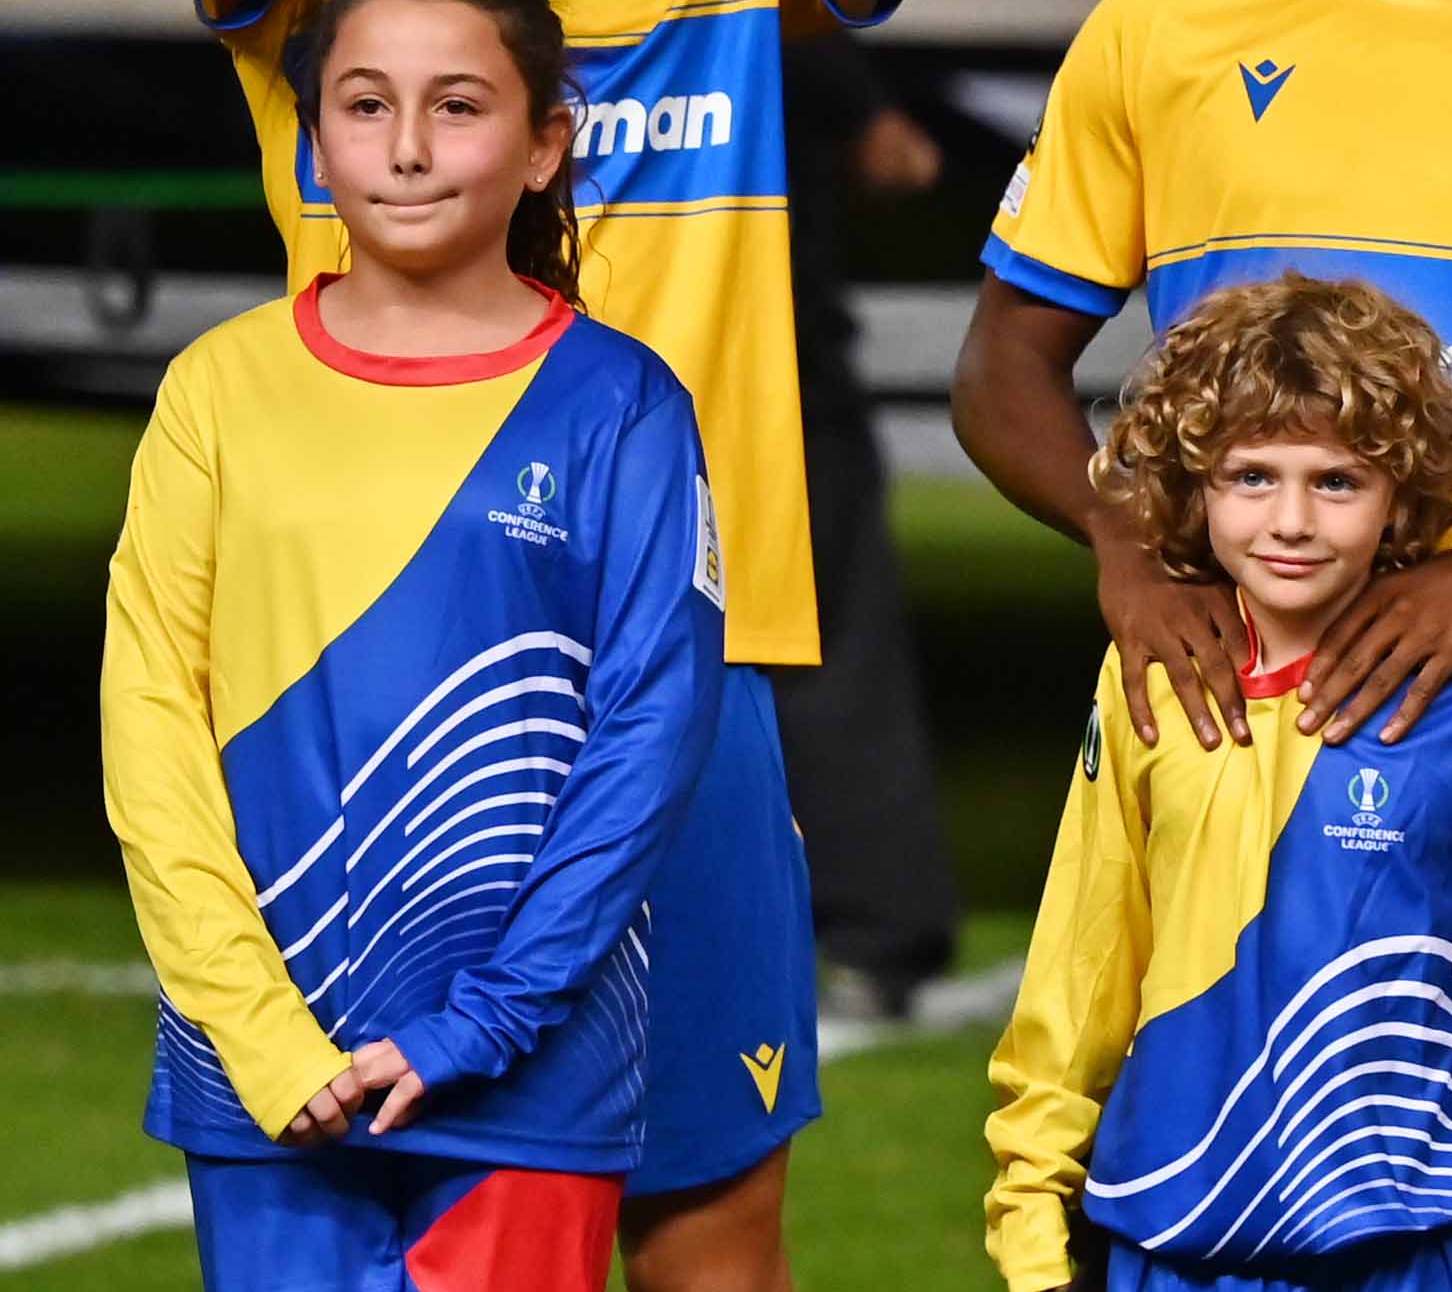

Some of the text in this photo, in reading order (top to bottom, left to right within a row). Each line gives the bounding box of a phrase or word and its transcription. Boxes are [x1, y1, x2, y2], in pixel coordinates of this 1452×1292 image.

[487, 510, 568, 542] CONFERENCE
[505, 526, 548, 546] LEAGUE
[1341, 839, 1388, 852] LEAGUE
